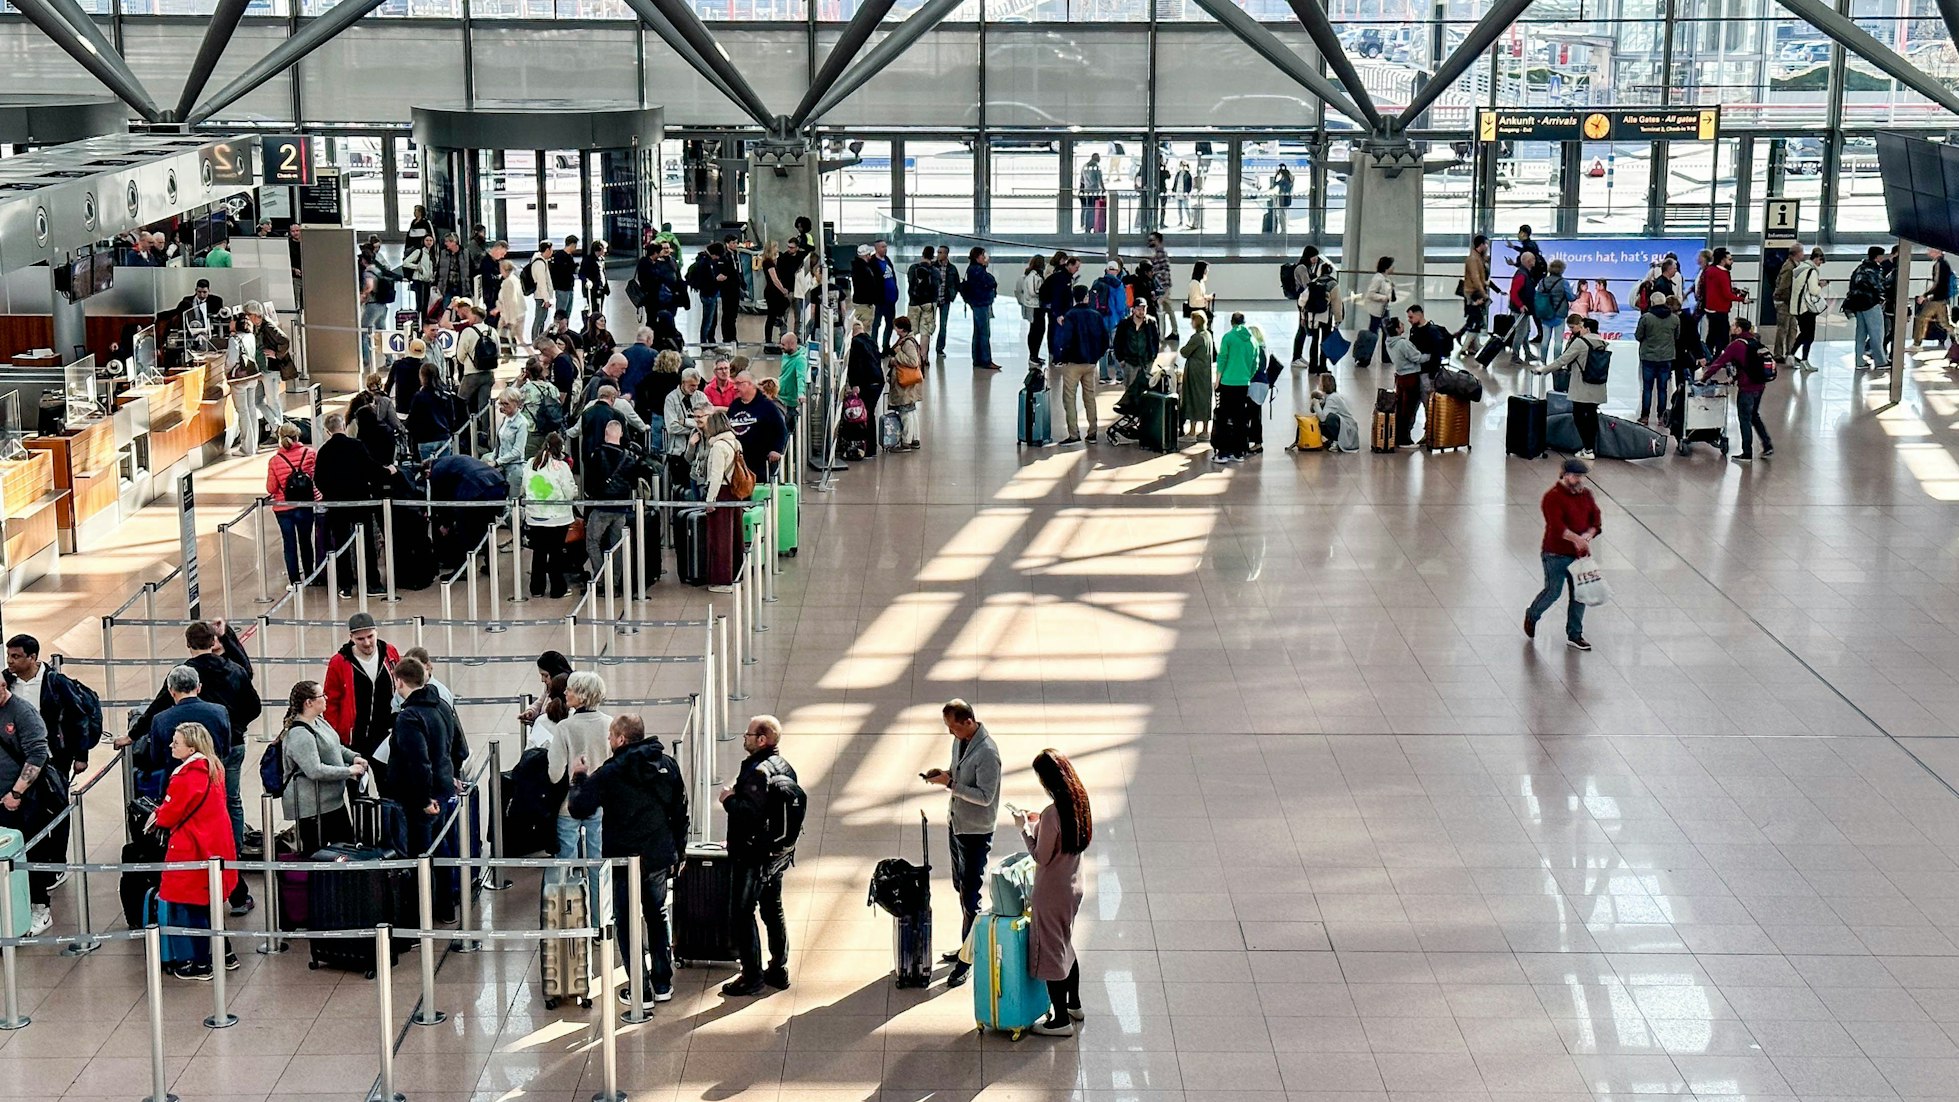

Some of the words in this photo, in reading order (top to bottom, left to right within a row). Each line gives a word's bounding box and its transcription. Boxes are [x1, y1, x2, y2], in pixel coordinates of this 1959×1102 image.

[1499, 116, 1535, 125] Ankunft
[1541, 116, 1578, 125] Arrivals
[1639, 116, 1660, 124] Gates
[1665, 115, 1677, 123] All
[1677, 116, 1697, 124] gates
[280, 144, 297, 170] 2
[1549, 251, 1592, 262] alltours
[1596, 251, 1618, 264] hat,
[1621, 251, 1648, 263] hat's
